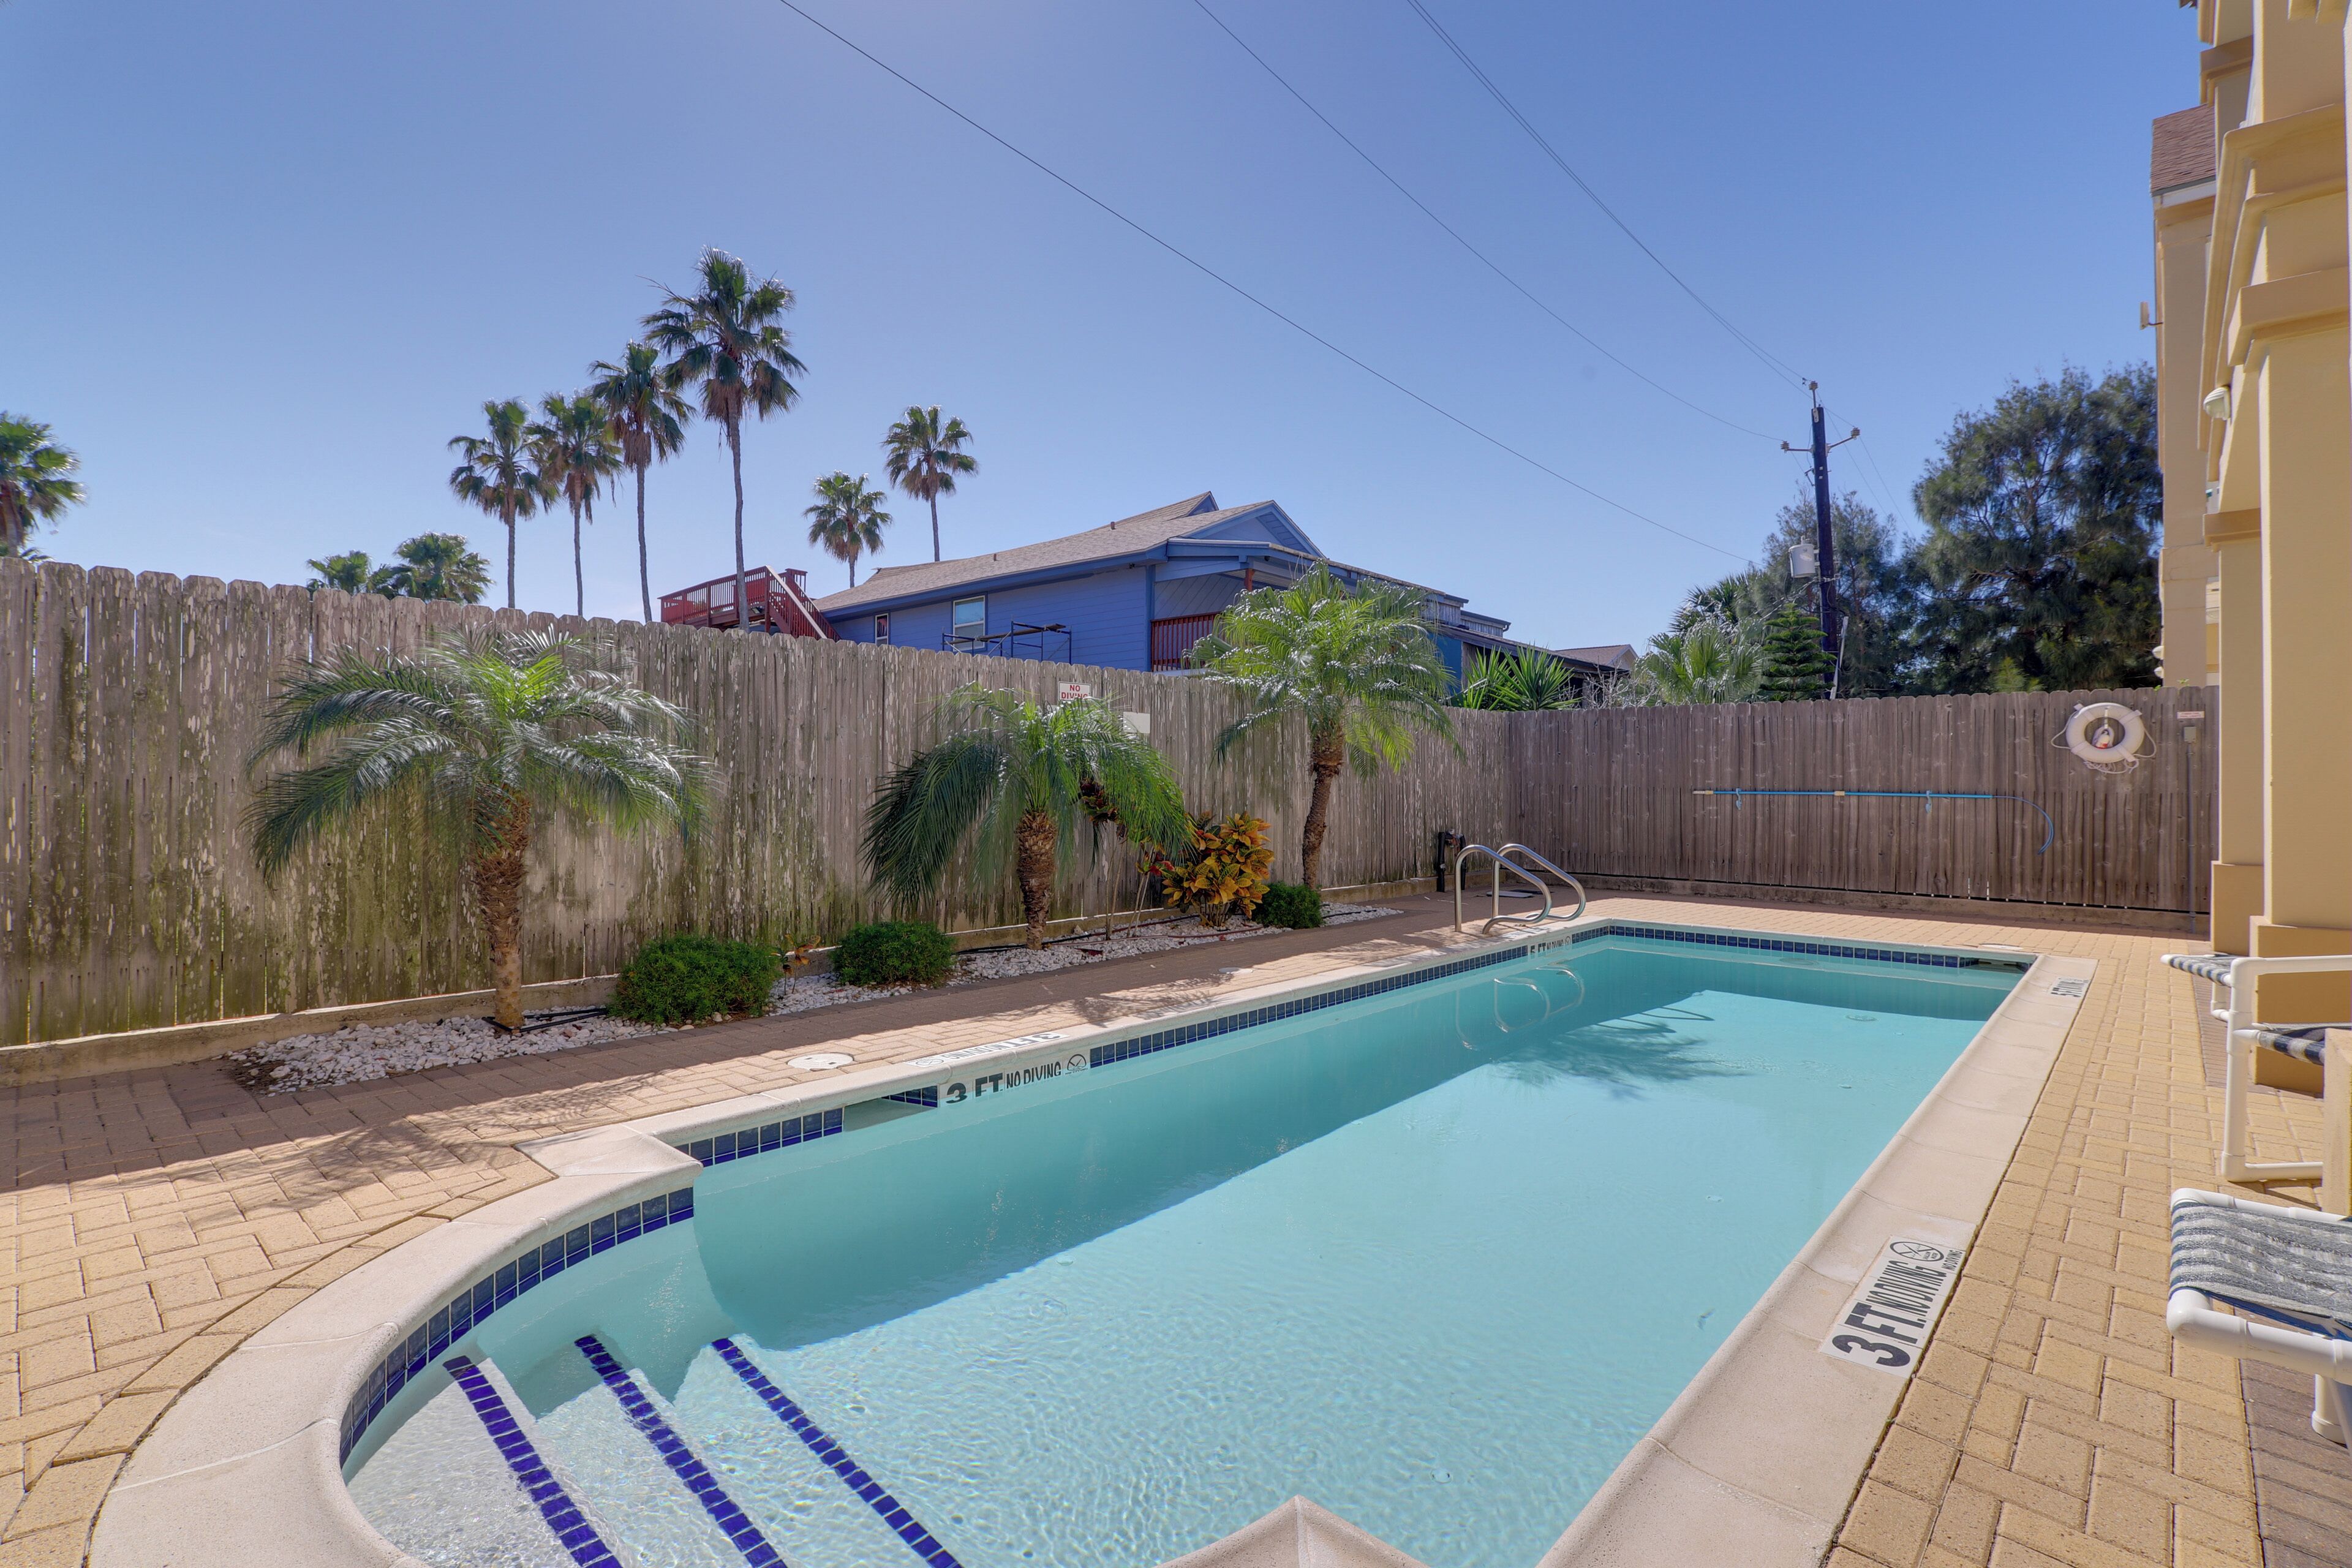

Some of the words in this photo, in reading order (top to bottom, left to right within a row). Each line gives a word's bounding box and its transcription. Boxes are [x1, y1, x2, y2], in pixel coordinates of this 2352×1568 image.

[941, 1047, 993, 1059] DIVING
[946, 1083, 968, 1104] 3
[1006, 1071, 1020, 1088] NO
[1023, 1061, 1061, 1084] DIVING
[1942, 1262, 1956, 1271] NO
[1944, 1250, 1962, 1265] DIVING
[1874, 1261, 1947, 1302] DIVING
[1866, 1291, 1931, 1317] NO
[1844, 1302, 1927, 1344] FT.
[1832, 1335, 1910, 1367] 3
